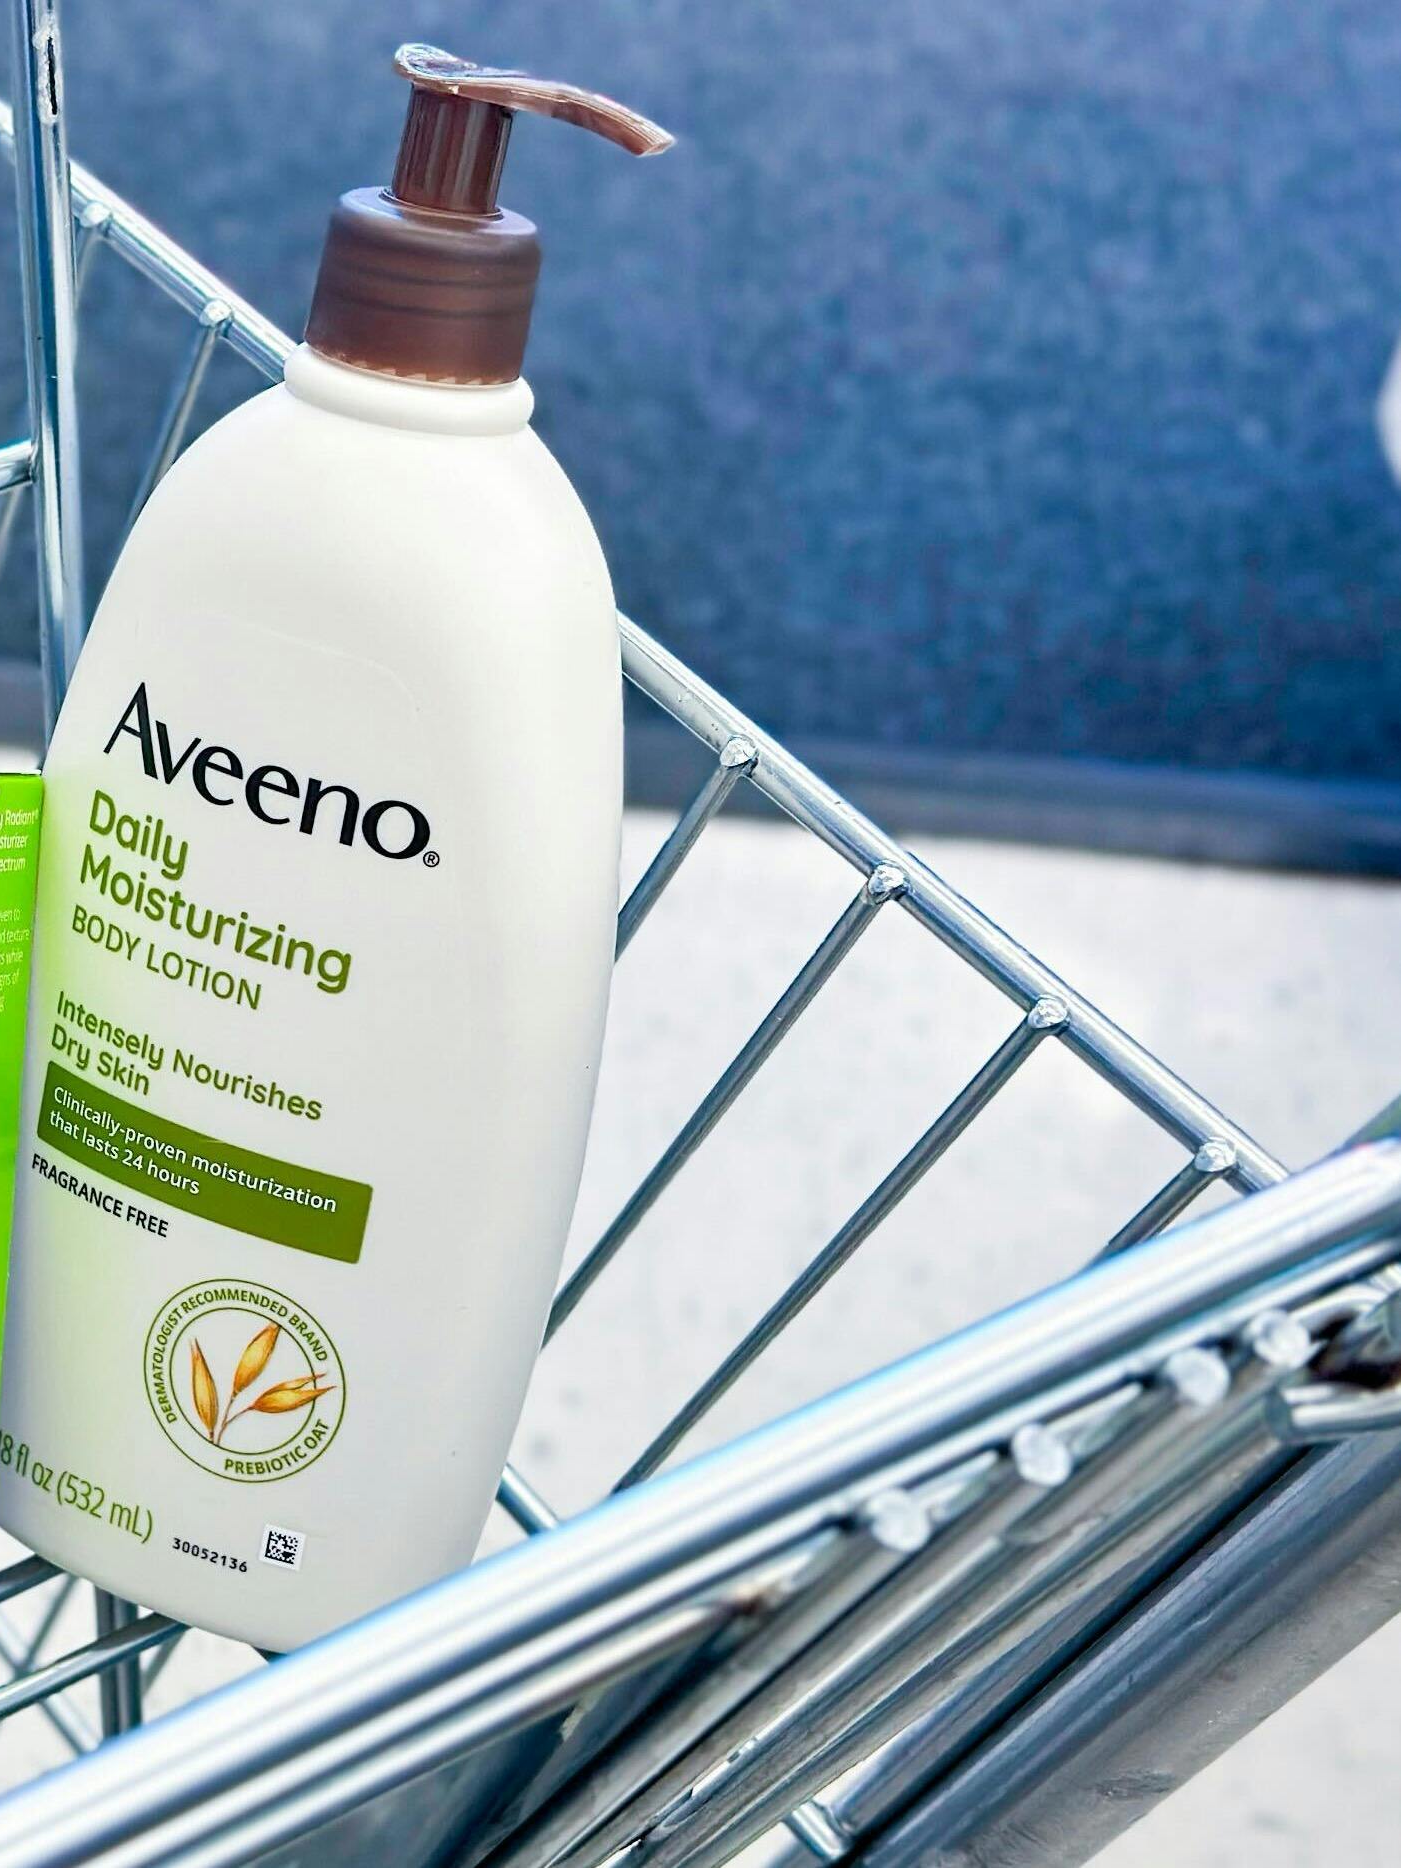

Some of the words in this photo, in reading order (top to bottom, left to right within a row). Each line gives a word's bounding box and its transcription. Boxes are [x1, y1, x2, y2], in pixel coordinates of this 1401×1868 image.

[103, 681, 441, 868] Aveeno®
[89, 789, 189, 881] Daily
[72, 904, 141, 962] BODY
[146, 943, 262, 1011] LOTION
[80, 844, 352, 995] Moisturizing
[51, 1024, 90, 1072] Dry
[96, 1048, 151, 1096] Skin
[56, 990, 165, 1070] Intensely
[173, 1048, 323, 1122] Nourishes
[31, 1153, 124, 1219] FRAGRANCE
[126, 1201, 169, 1238] FREE
[49, 1109, 80, 1138] that
[82, 1123, 119, 1159] lasts
[123, 1147, 144, 1171] 24
[147, 1155, 200, 1195] hours
[54, 1085, 188, 1163] Clinically-proven
[192, 1152, 337, 1213] moisturization
[152, 1308, 184, 1425] DERMATOLOGIST
[180, 1288, 288, 1319] RECOMMENDED
[288, 1314, 329, 1362] BRAND
[15, 1443, 30, 1477] fl
[31, 1461, 54, 1494] oz
[56, 1470, 106, 1519] (532
[109, 1501, 154, 1545] mL)
[224, 1445, 308, 1476] PREBIOTIC
[303, 1418, 330, 1451] OAT
[172, 1537, 249, 1574] 30052136
